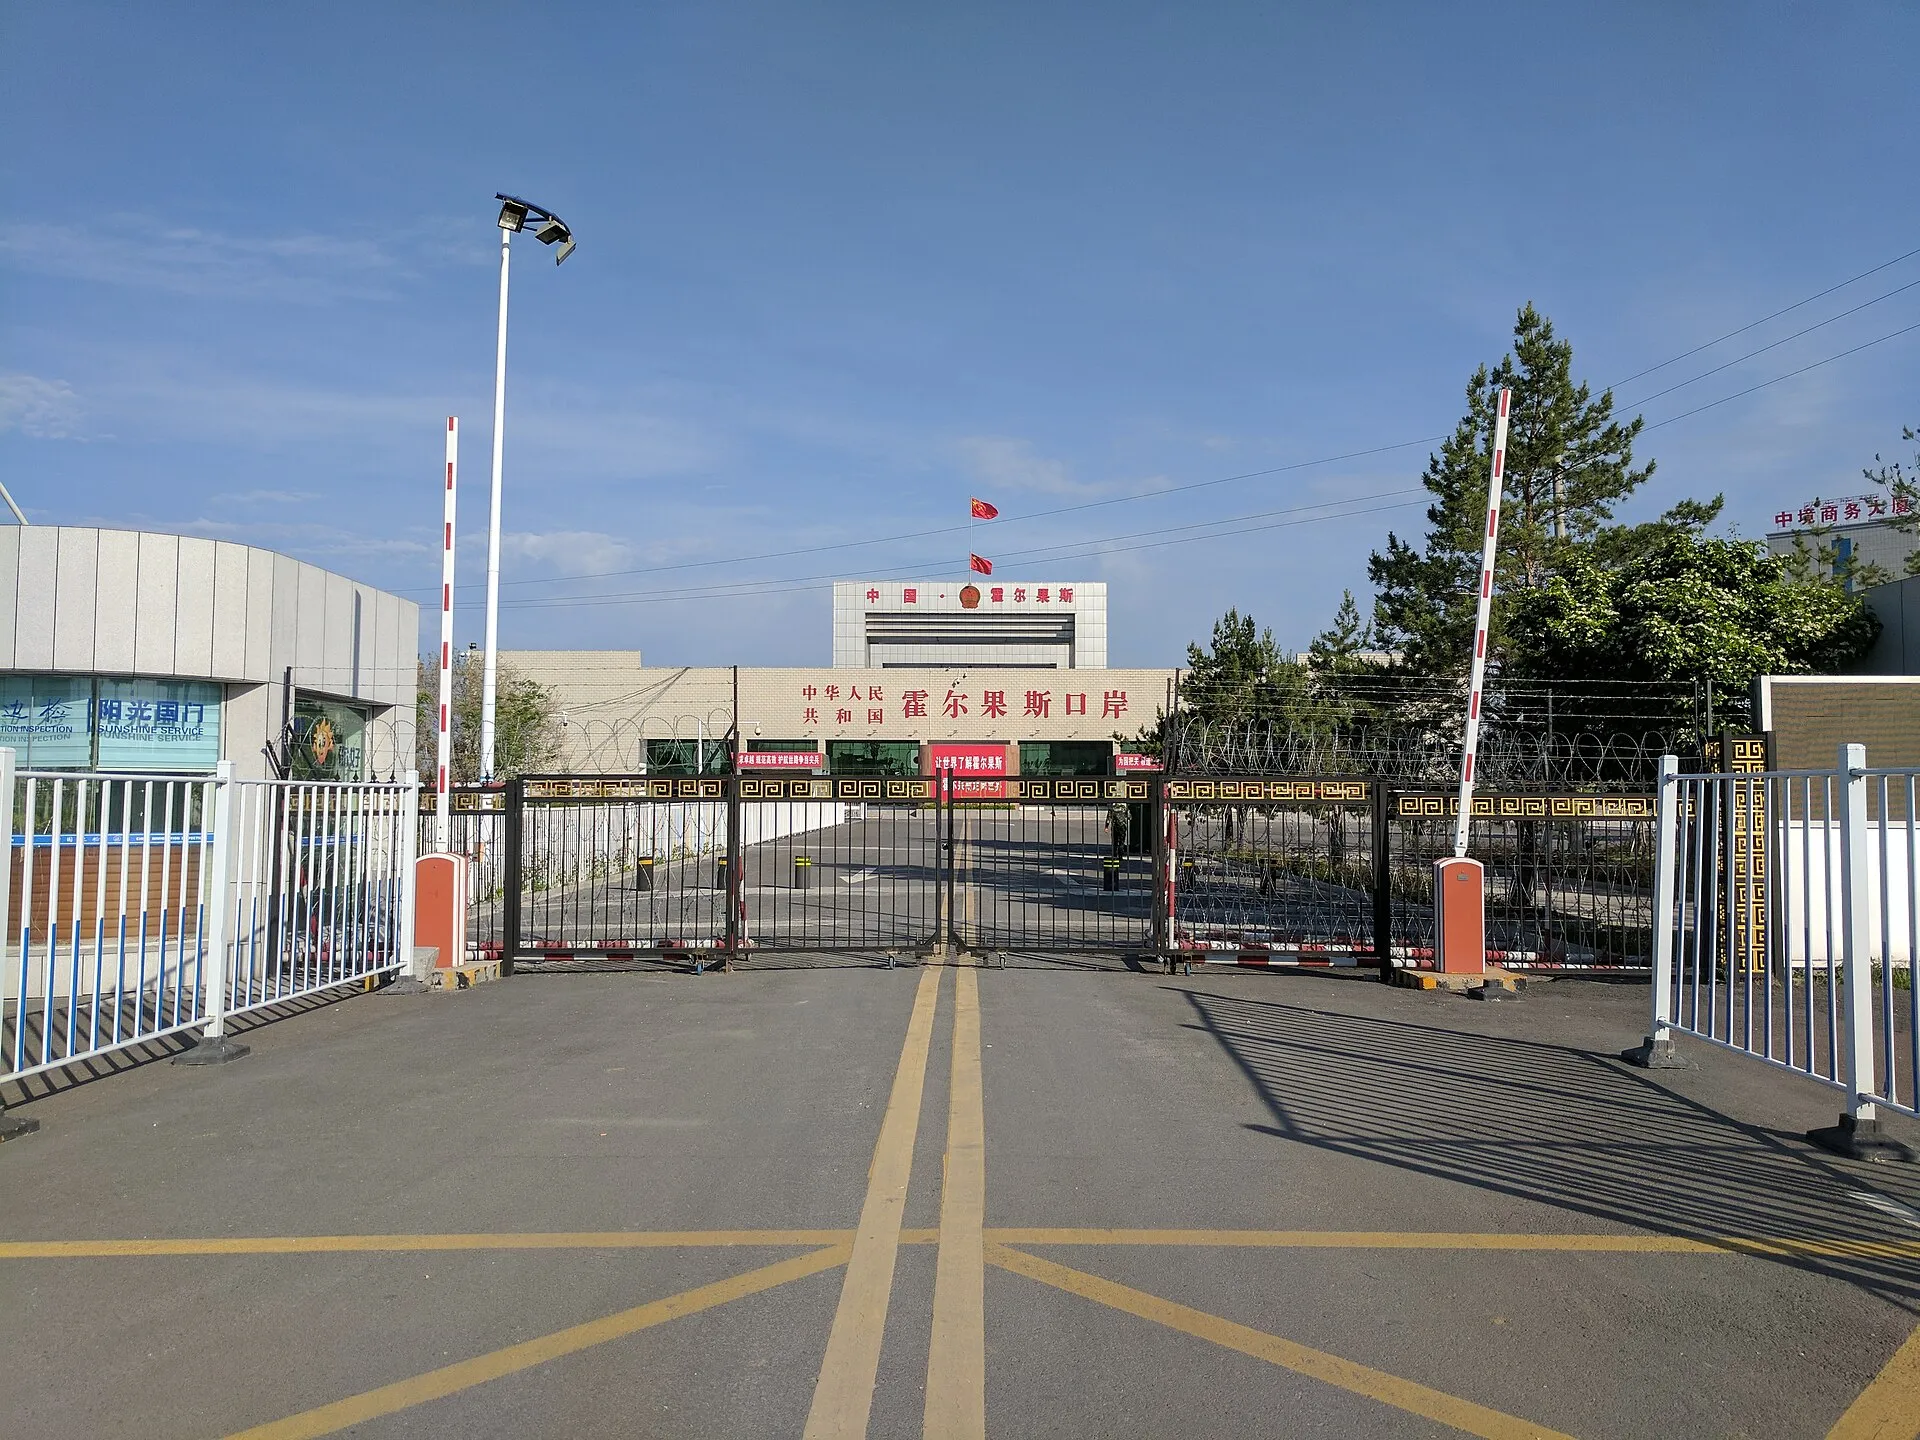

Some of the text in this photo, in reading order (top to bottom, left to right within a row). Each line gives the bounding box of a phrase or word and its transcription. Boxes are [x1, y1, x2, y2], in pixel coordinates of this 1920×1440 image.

[802, 685, 884, 701] 中华人民
[98, 699, 204, 723] 阳光国门
[901, 689, 1129, 719] 霍尔果斯口岸
[802, 708, 884, 724] 共和国
[20, 725, 73, 733] INSPECTION
[98, 724, 204, 736] SUNSHINE SERVICE
[935, 756, 1003, 770] 让世界了解霍尔果斯
